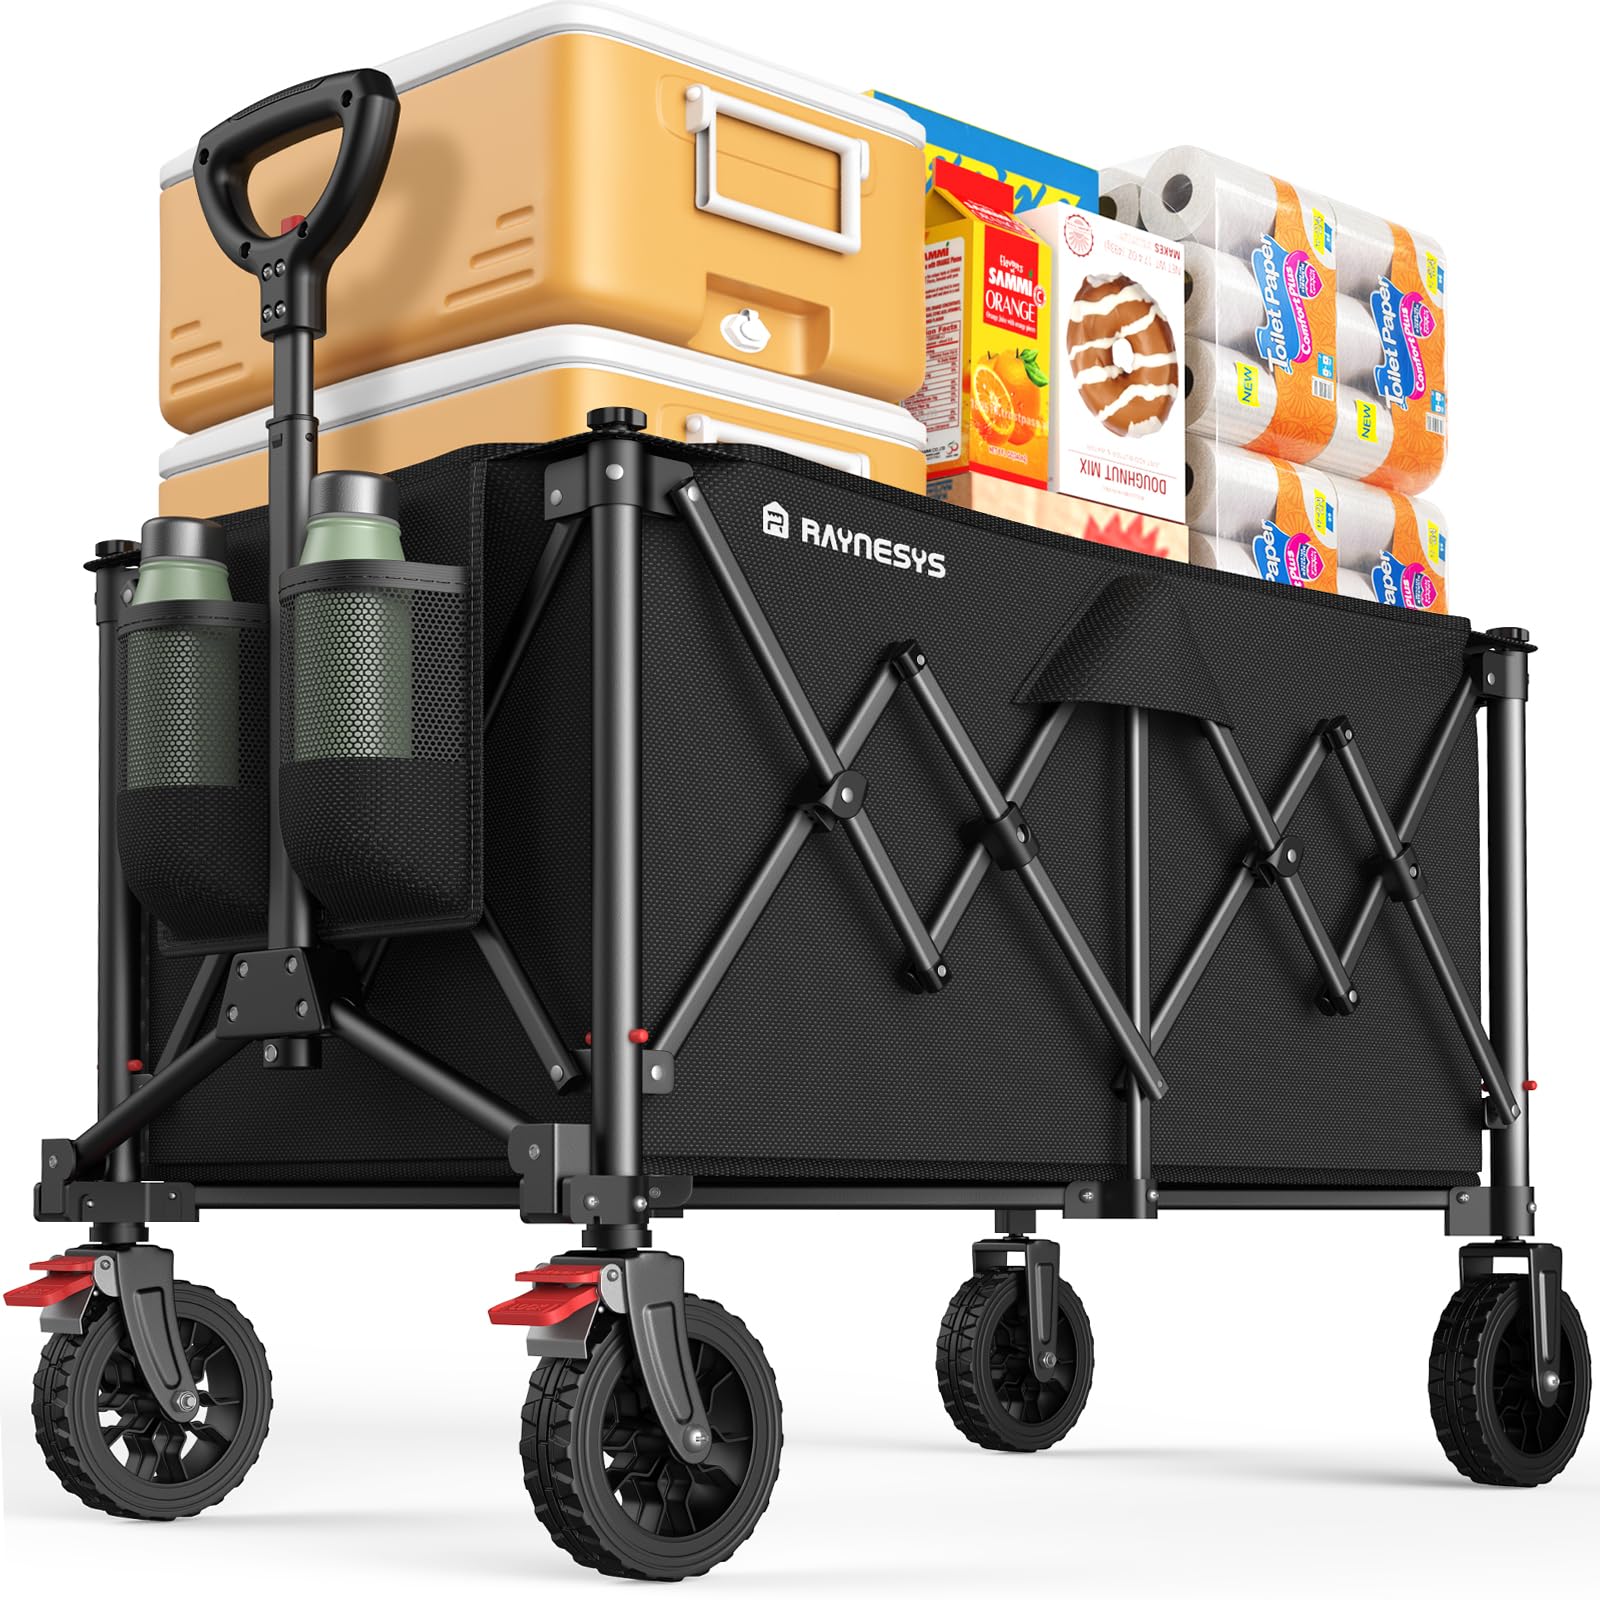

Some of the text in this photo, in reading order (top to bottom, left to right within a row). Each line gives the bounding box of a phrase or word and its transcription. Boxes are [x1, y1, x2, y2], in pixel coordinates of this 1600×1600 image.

[1154, 243, 1181, 260] MAKES
[989, 267, 1033, 297] SAMMI
[985, 289, 1036, 323] ORANGE
[1260, 232, 1289, 372] Toilet Paper
[1286, 265, 1311, 355] Comfort Plus
[1377, 275, 1405, 409] Toilet Paper
[1401, 307, 1425, 392] Comfort Plus
[1242, 366, 1253, 403] NEW
[1361, 404, 1372, 438] NEW
[1080, 457, 1101, 478] MIX
[1105, 465, 1167, 495] DOUGHNUT
[801, 517, 946, 579] RAYNESYS
[1287, 550, 1301, 580] Plus
[1379, 549, 1398, 605] aper
[1402, 579, 1415, 608] Plus
